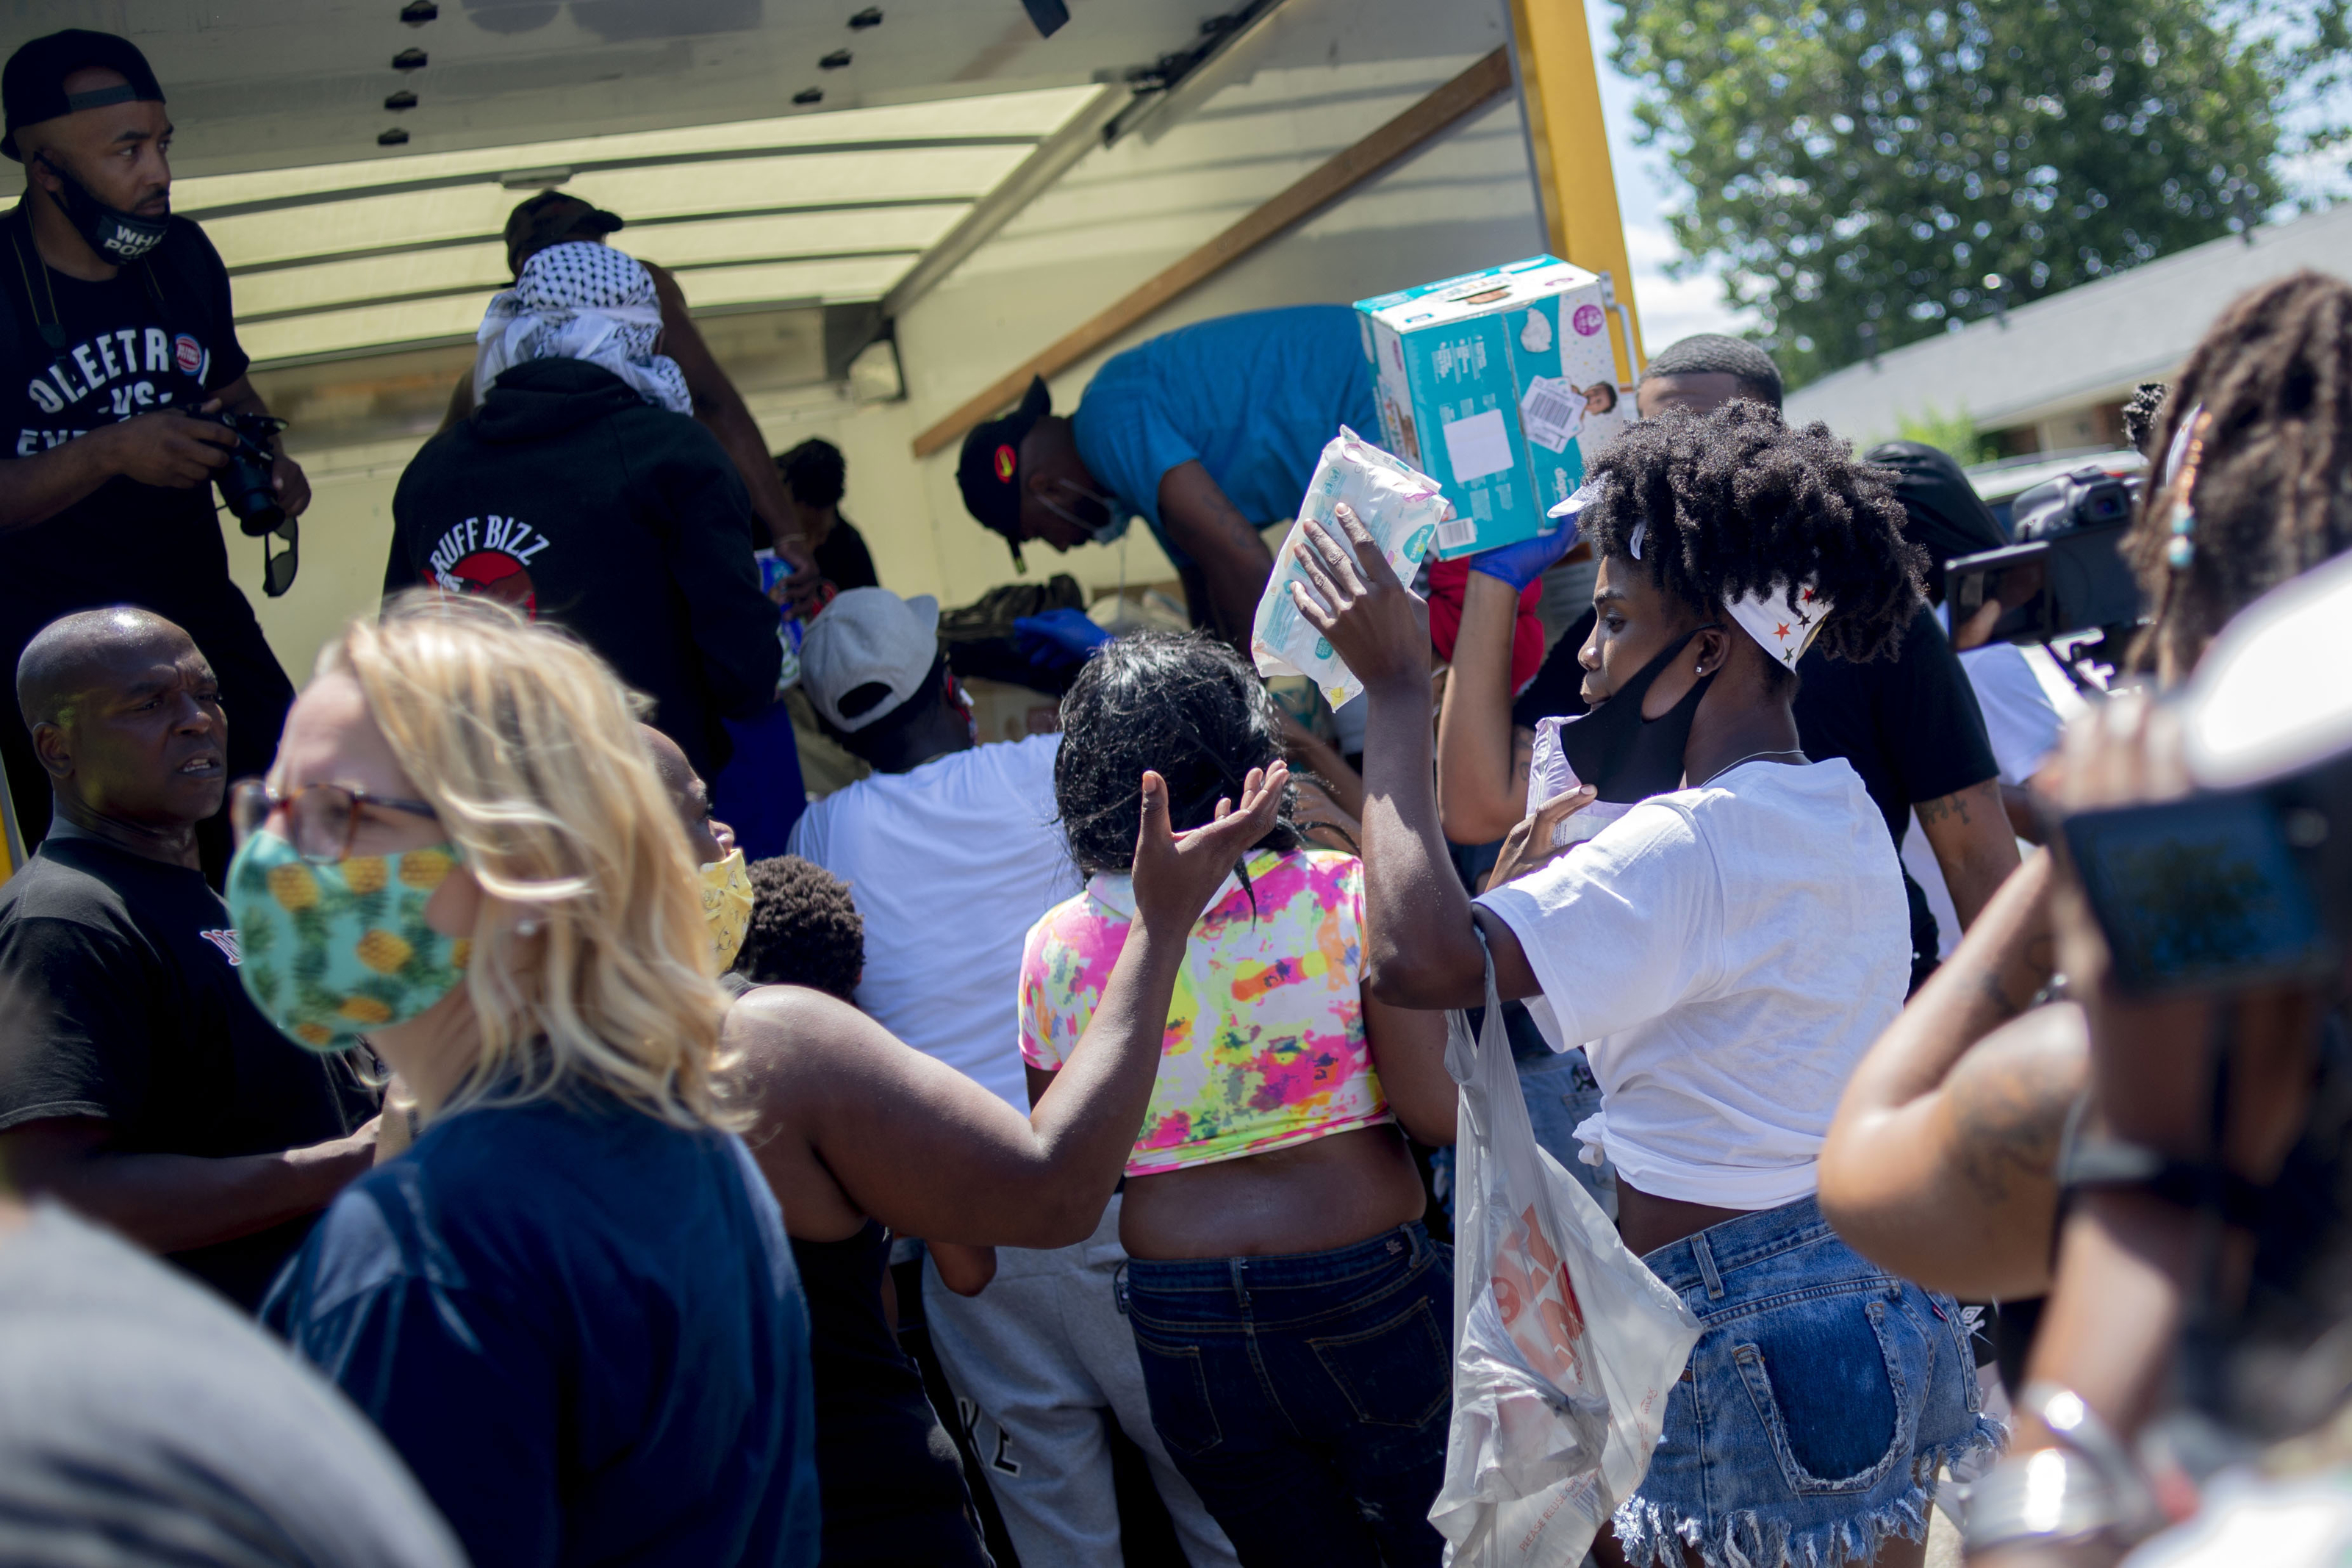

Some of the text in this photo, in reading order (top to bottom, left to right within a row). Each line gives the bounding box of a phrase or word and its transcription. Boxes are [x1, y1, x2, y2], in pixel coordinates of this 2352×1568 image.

[429, 514, 550, 574] RUFF BIZZ
[1643, 1387, 1654, 1414] HILEX
[1519, 1477, 1580, 1552] PLEASE REUSE OR
